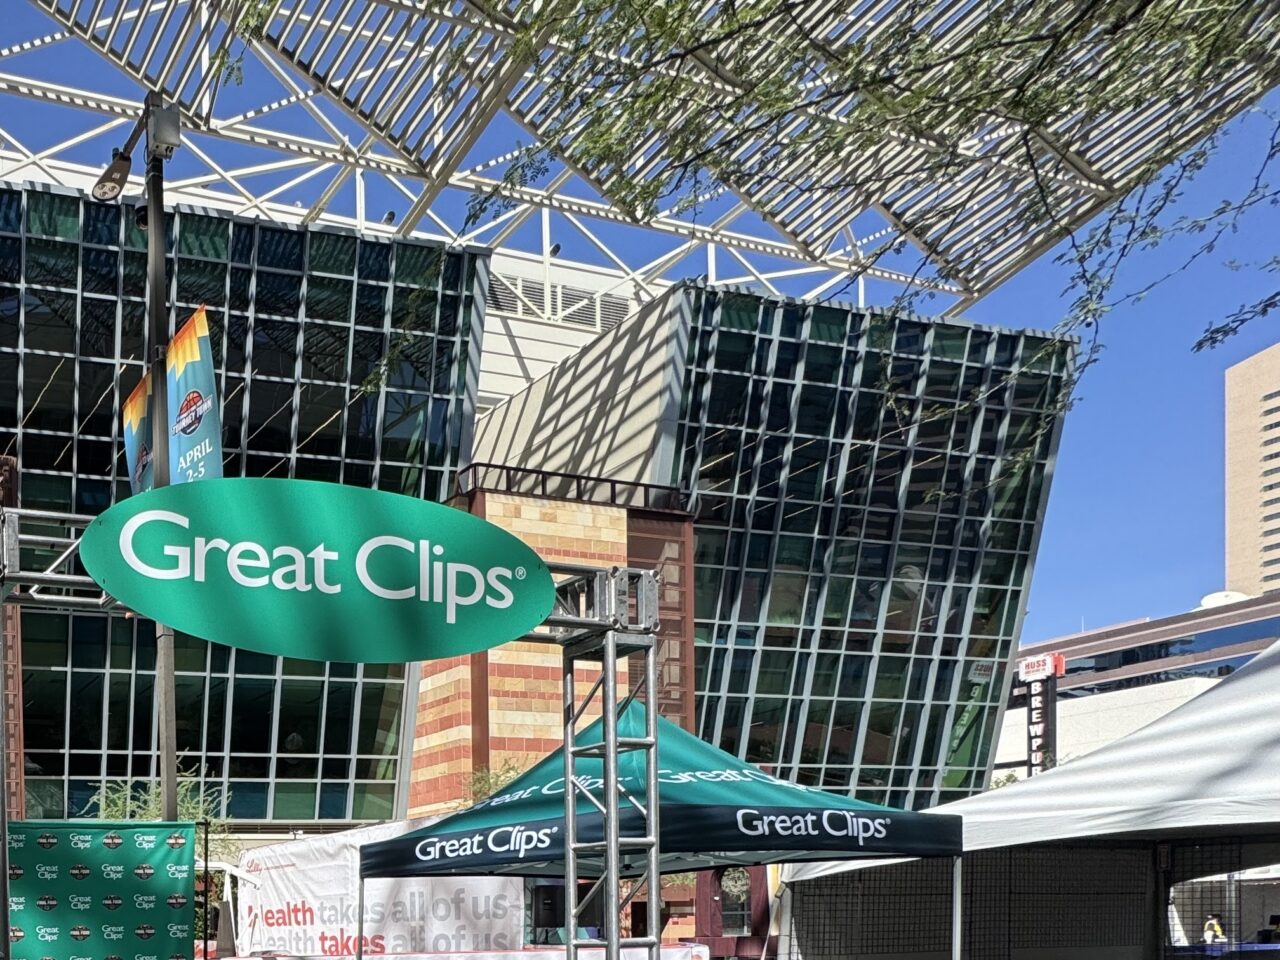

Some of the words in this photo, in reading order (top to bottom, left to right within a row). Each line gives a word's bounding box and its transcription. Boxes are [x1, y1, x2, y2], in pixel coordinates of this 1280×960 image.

[177, 438, 213, 472] APRIL
[186, 461, 205, 483] 2-5
[119, 509, 341, 593] Great
[1024, 659, 1046, 670] HUSS
[658, 769, 753, 784] Great
[736, 809, 818, 836] Great
[70, 833, 92, 841] Great
[134, 833, 157, 841] Great
[71, 840, 91, 849] Clips
[135, 840, 156, 849] Clips
[415, 832, 483, 861] Great
[36, 864, 59, 872] Great
[102, 864, 124, 872] Great
[167, 864, 190, 872] Great
[37, 871, 58, 880] Clips
[103, 871, 123, 880] Clips
[168, 871, 189, 880] Clips
[69, 895, 92, 903] Great
[134, 894, 156, 902] Great
[70, 902, 91, 911] Clips
[135, 901, 155, 910] Clips
[317, 898, 384, 925] takes
[391, 890, 425, 922] all
[432, 888, 465, 921] of
[471, 893, 508, 920] us
[36, 926, 60, 934] Great
[102, 925, 125, 933] Great
[168, 924, 190, 932] Great
[37, 933, 59, 943] Clips
[103, 932, 124, 941] Clips
[169, 931, 189, 939] Clips
[318, 928, 385, 955] takes
[392, 925, 425, 950] all
[432, 925, 465, 950] of
[472, 929, 509, 950] us
